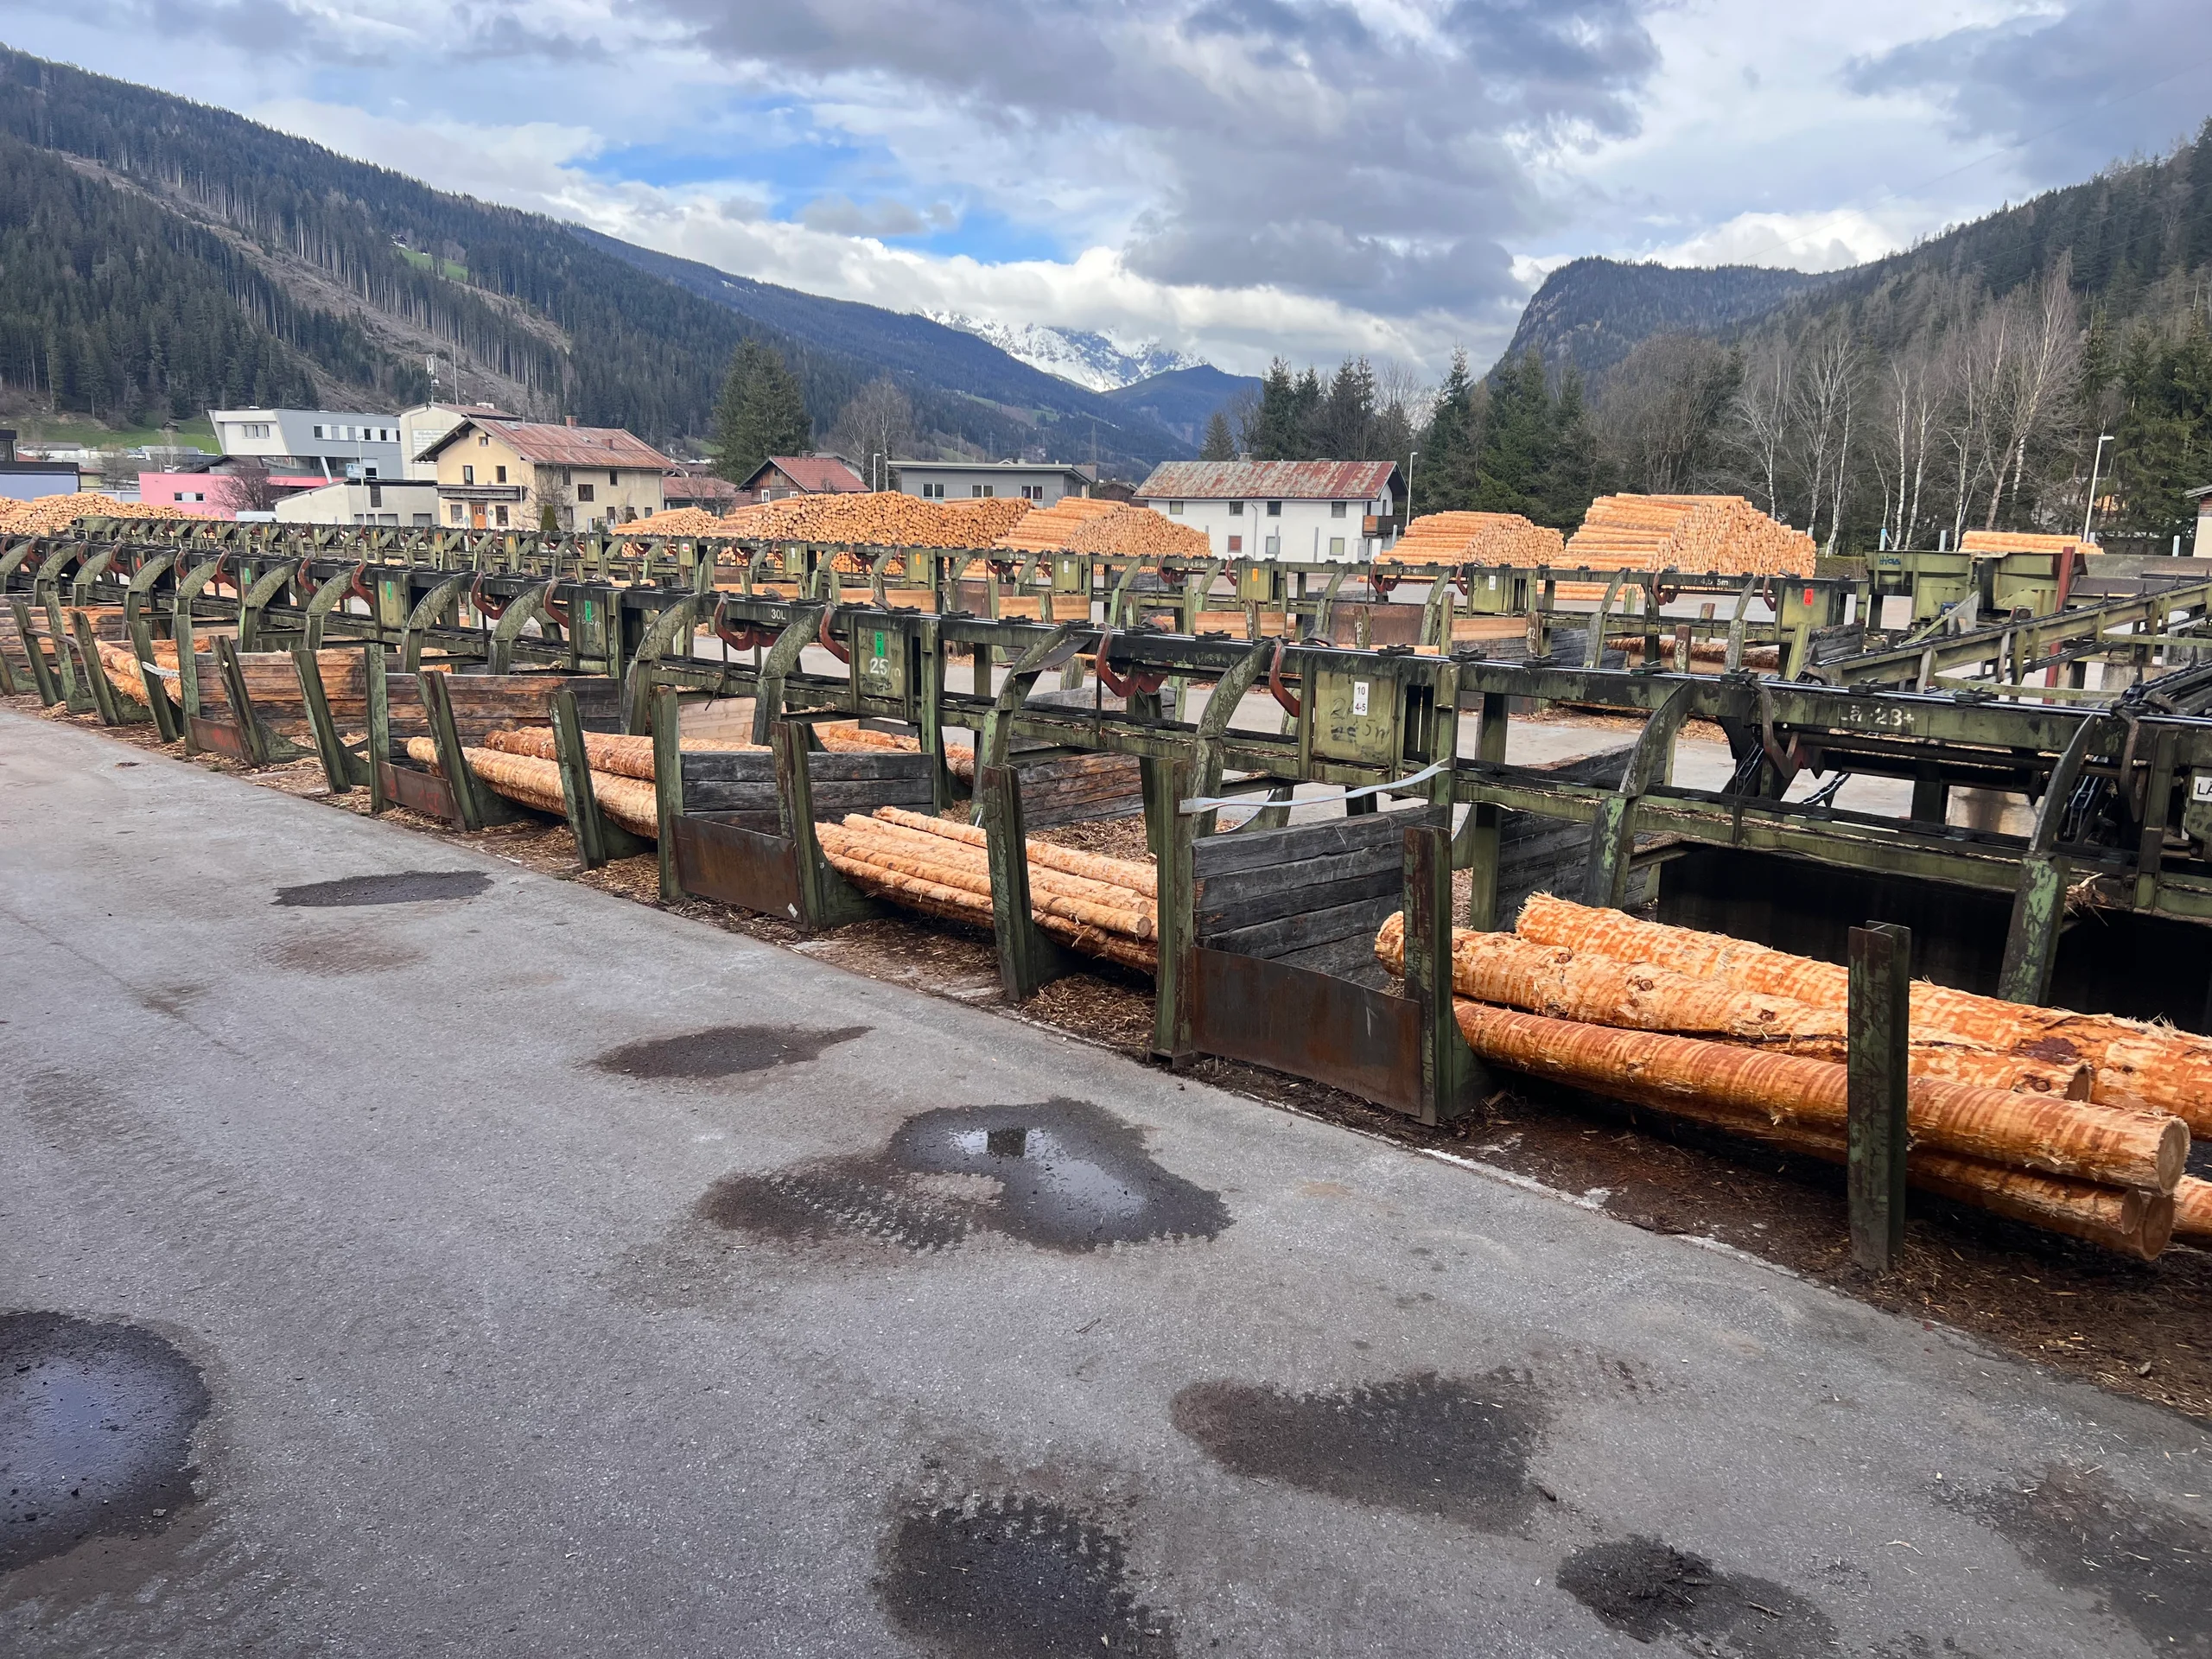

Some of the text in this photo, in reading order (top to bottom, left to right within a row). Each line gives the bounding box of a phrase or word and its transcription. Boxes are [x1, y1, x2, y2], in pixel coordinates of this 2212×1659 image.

[771, 608, 786, 620] 30L
[1357, 686, 1366, 696] 10
[1355, 702, 1366, 712] 4-5
